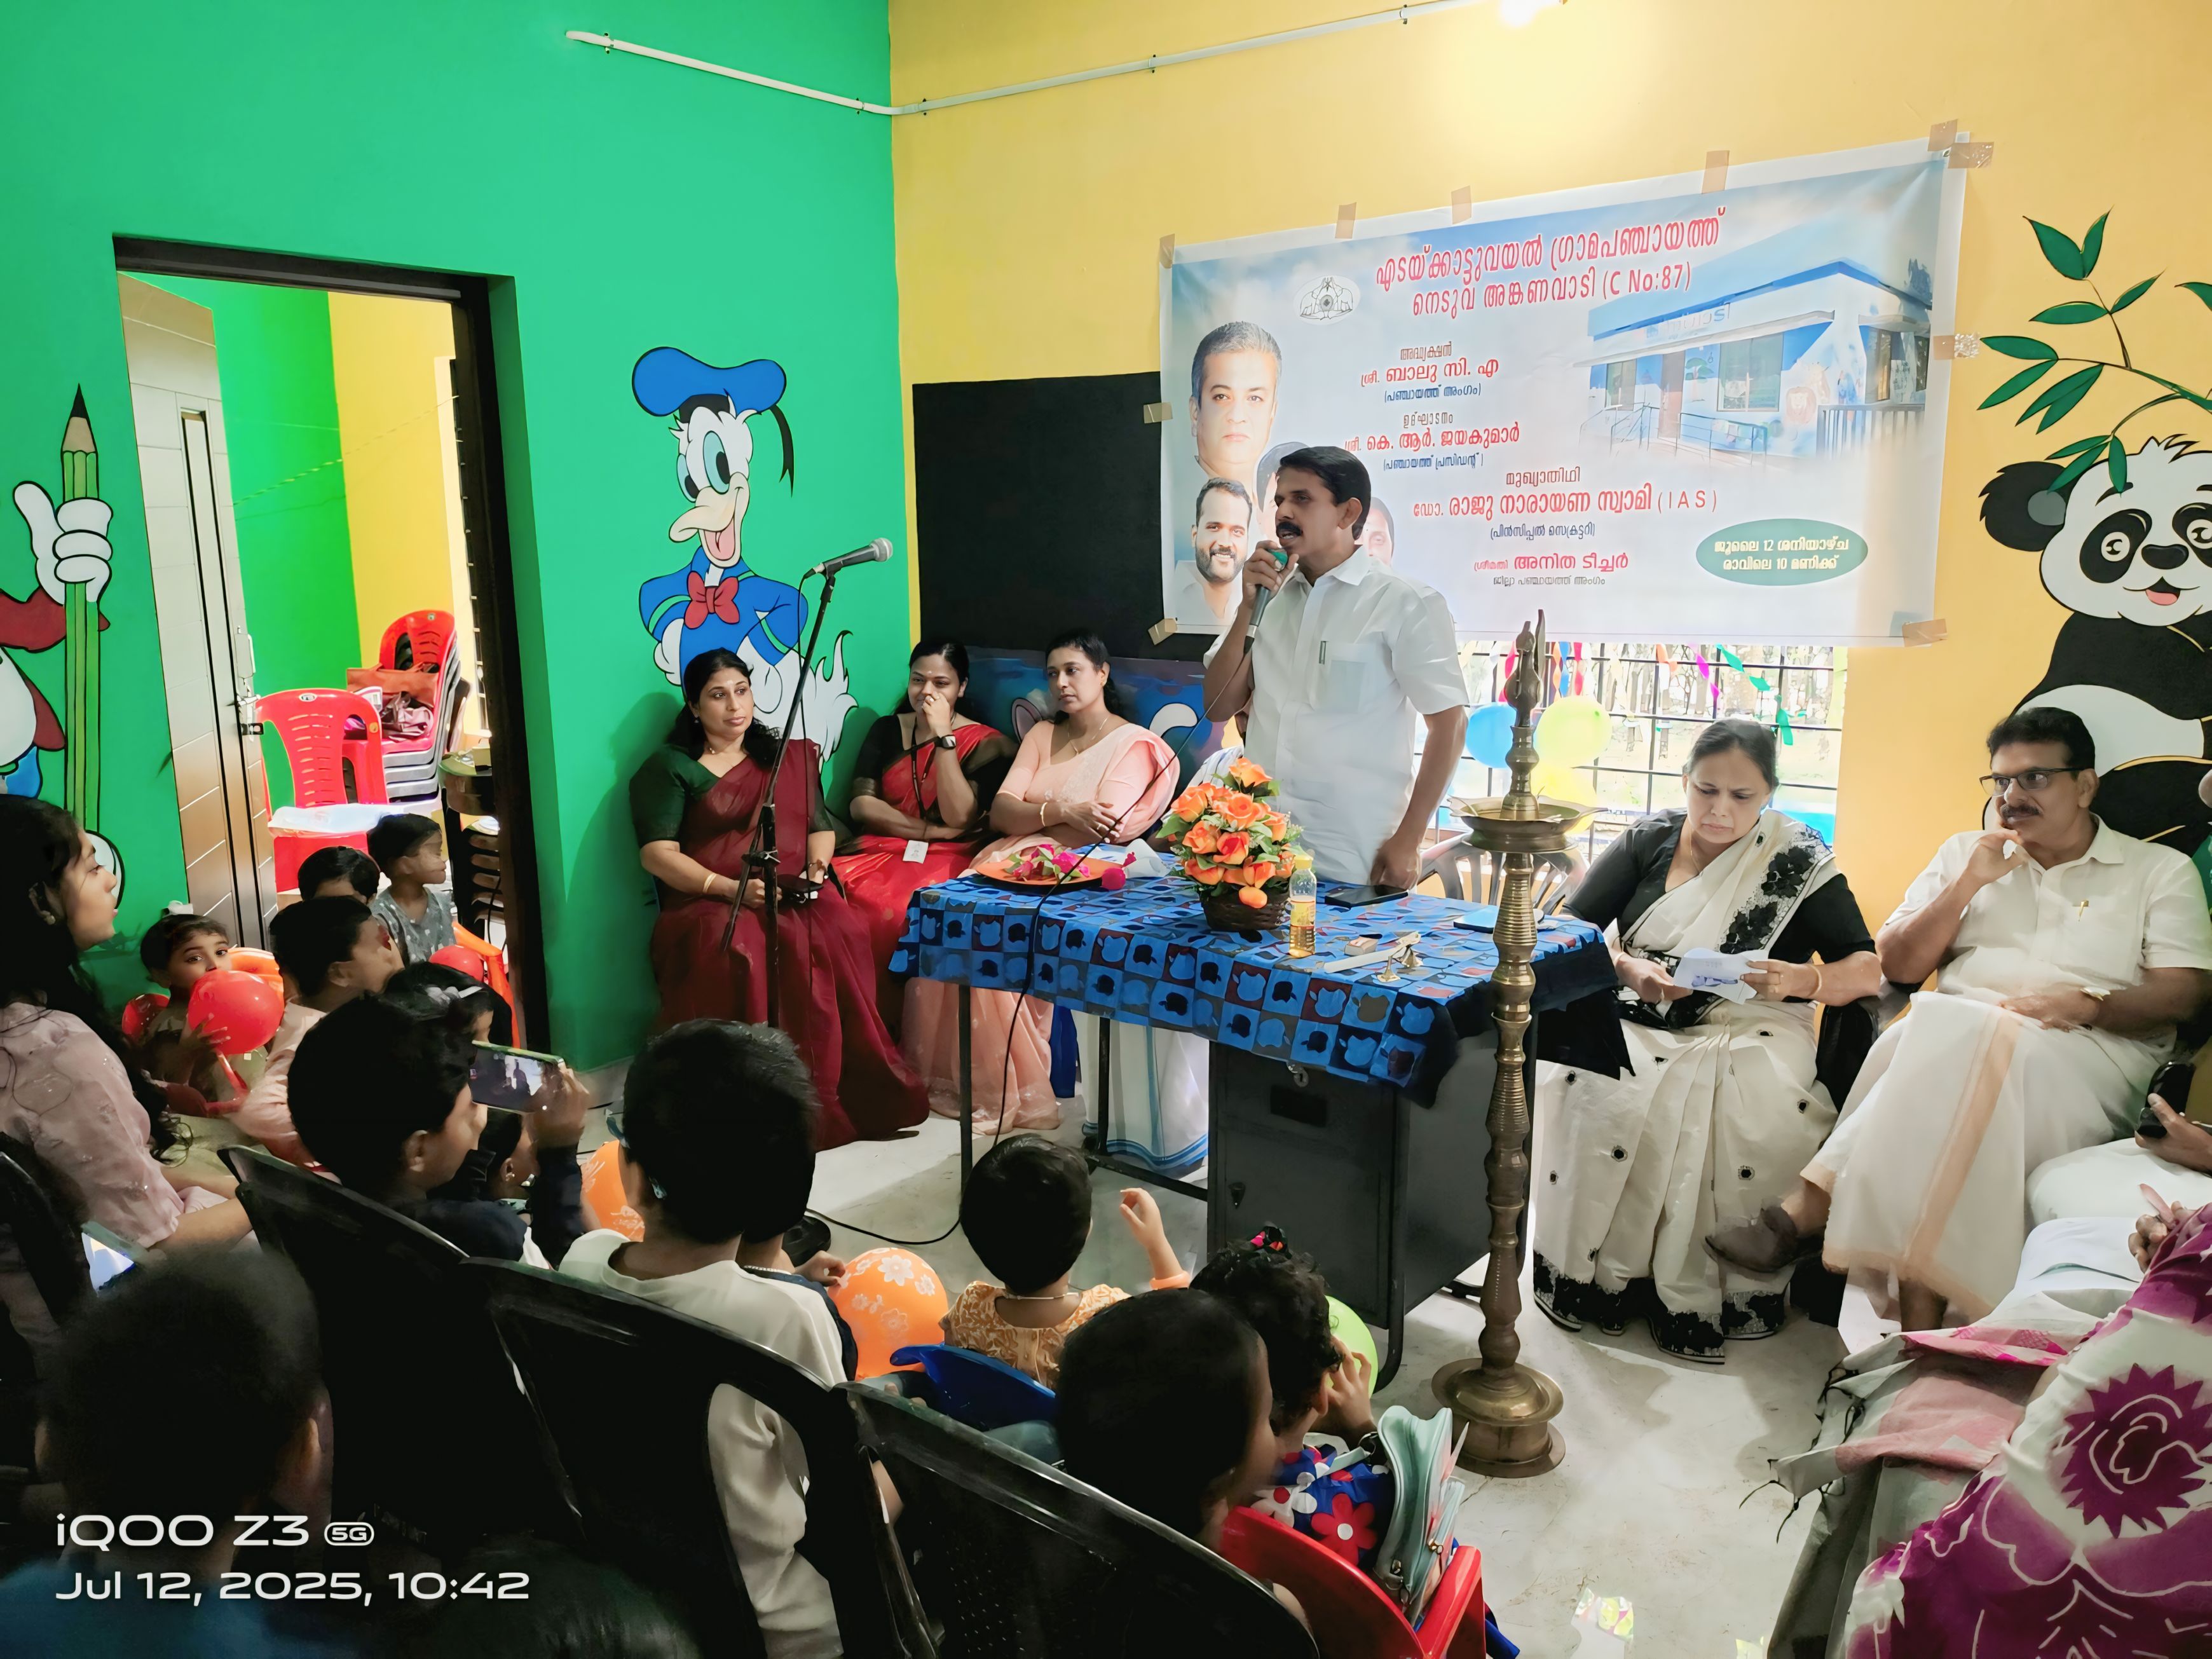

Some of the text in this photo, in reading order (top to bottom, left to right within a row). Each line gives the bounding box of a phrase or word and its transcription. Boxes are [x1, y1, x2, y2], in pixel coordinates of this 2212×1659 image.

[1376, 206, 1726, 292] എടയ്ക്കാട്ടുവയൽ ഗ്രാമപഞ്ചായത്ത്
[1412, 287, 1475, 320] നെടുവ
[1484, 266, 1595, 308] അങ്കണവാടി
[1386, 364, 1438, 383] ബാലു
[1444, 357, 1471, 377] സി.
[1477, 358, 1499, 378] എ
[1367, 435, 1394, 451] കെ.
[1399, 427, 1436, 452] ആർ.
[1440, 421, 1520, 449] ജയകുമാർ
[1506, 466, 1581, 488] മുഖ്യാതിഥി
[1413, 503, 1444, 517] ഡോ.
[1449, 495, 1493, 521] രാജു
[1500, 491, 1590, 514] നാരായണ
[1598, 482, 1652, 514] സ്വാമി
[1763, 539, 1774, 552] 12
[1514, 552, 1576, 570] അനിത
[1583, 552, 1628, 572] ടീച്ചർ
[1723, 556, 1772, 570] രാവിലെ
[1777, 557, 1787, 570] 10
